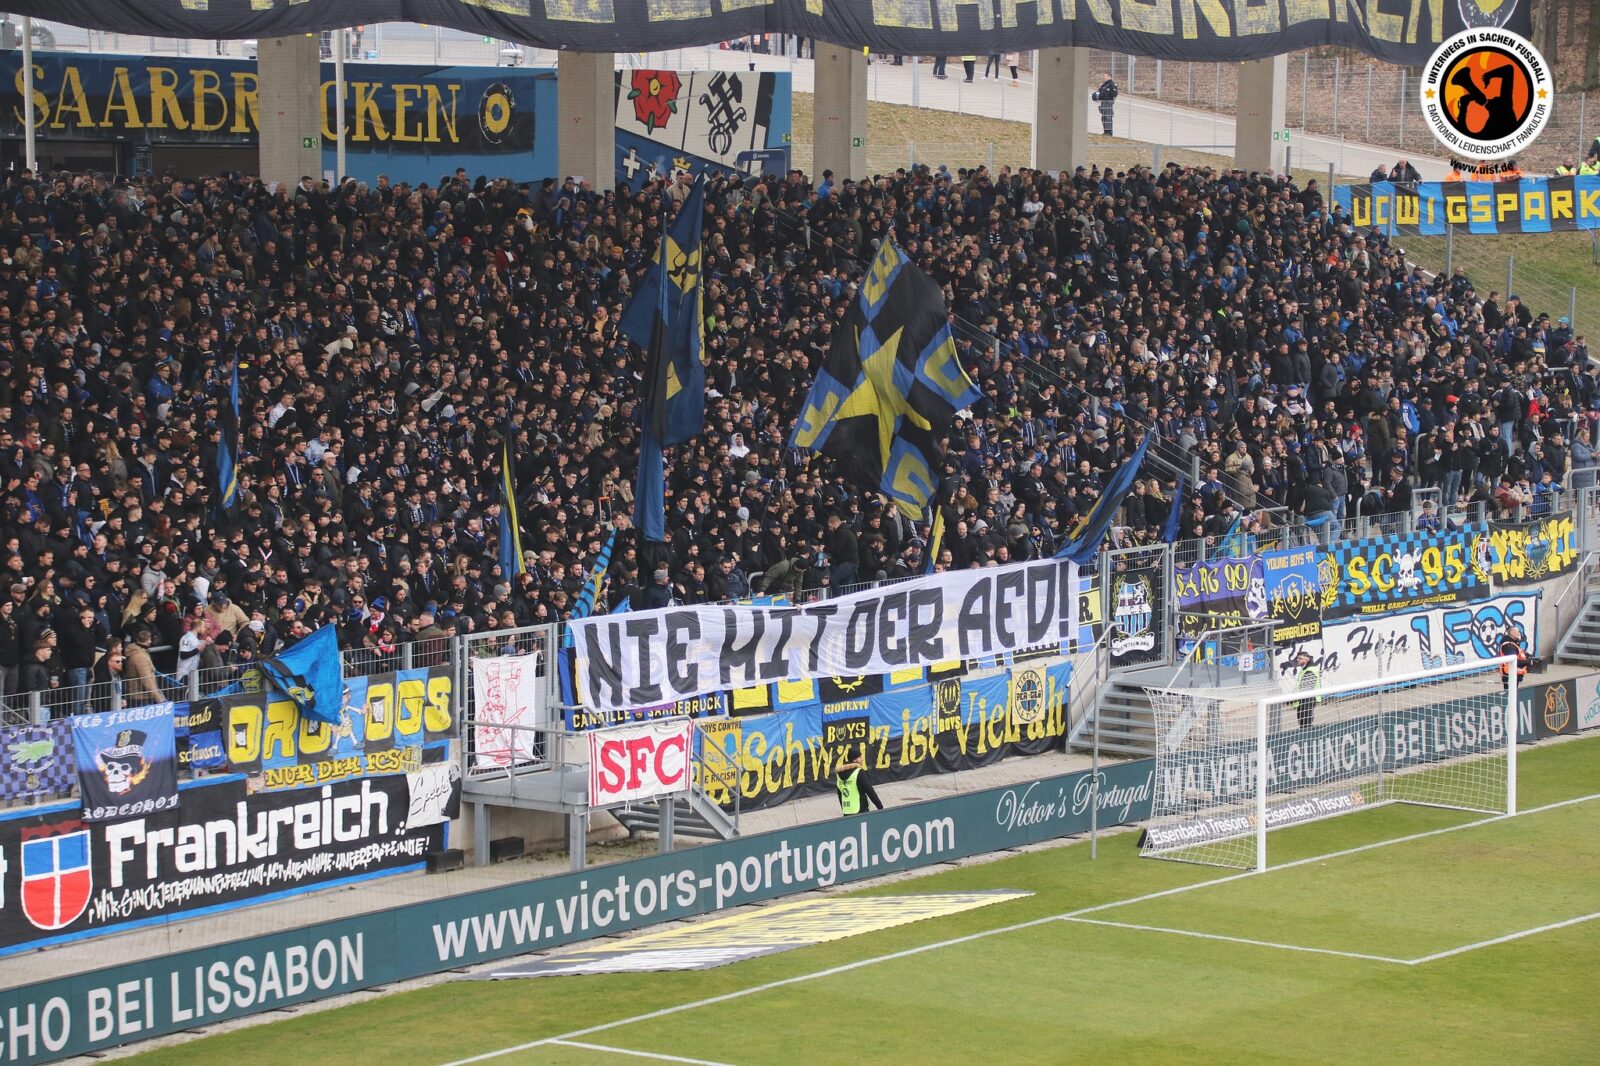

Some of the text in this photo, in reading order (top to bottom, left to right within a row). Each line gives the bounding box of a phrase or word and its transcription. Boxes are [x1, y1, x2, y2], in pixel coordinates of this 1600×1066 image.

[14, 64, 460, 142] SAARBRCKEN
[1224, 563, 1248, 591] 99
[1266, 557, 1288, 570] YOUNG
[1290, 553, 1304, 566] BOYS
[1347, 543, 1465, 595] SC 95
[585, 611, 701, 708] NIE
[719, 604, 839, 684] MIT
[845, 587, 944, 669] DER
[72, 702, 174, 729] FCS FREUNDE
[940, 716, 960, 732] BOYS
[599, 734, 685, 793] SFC
[1394, 719, 1427, 761] BEI
[266, 749, 402, 787] NUR DER FCS
[996, 771, 1153, 832] Victor's Portugal
[1265, 800, 1315, 824] Eisenbach
[105, 780, 389, 889] Frankreich
[1149, 822, 1208, 845] Eisenbach
[432, 816, 956, 961] www.victors-portugal.com
[0, 932, 364, 1060] HO BEI LISSABON
